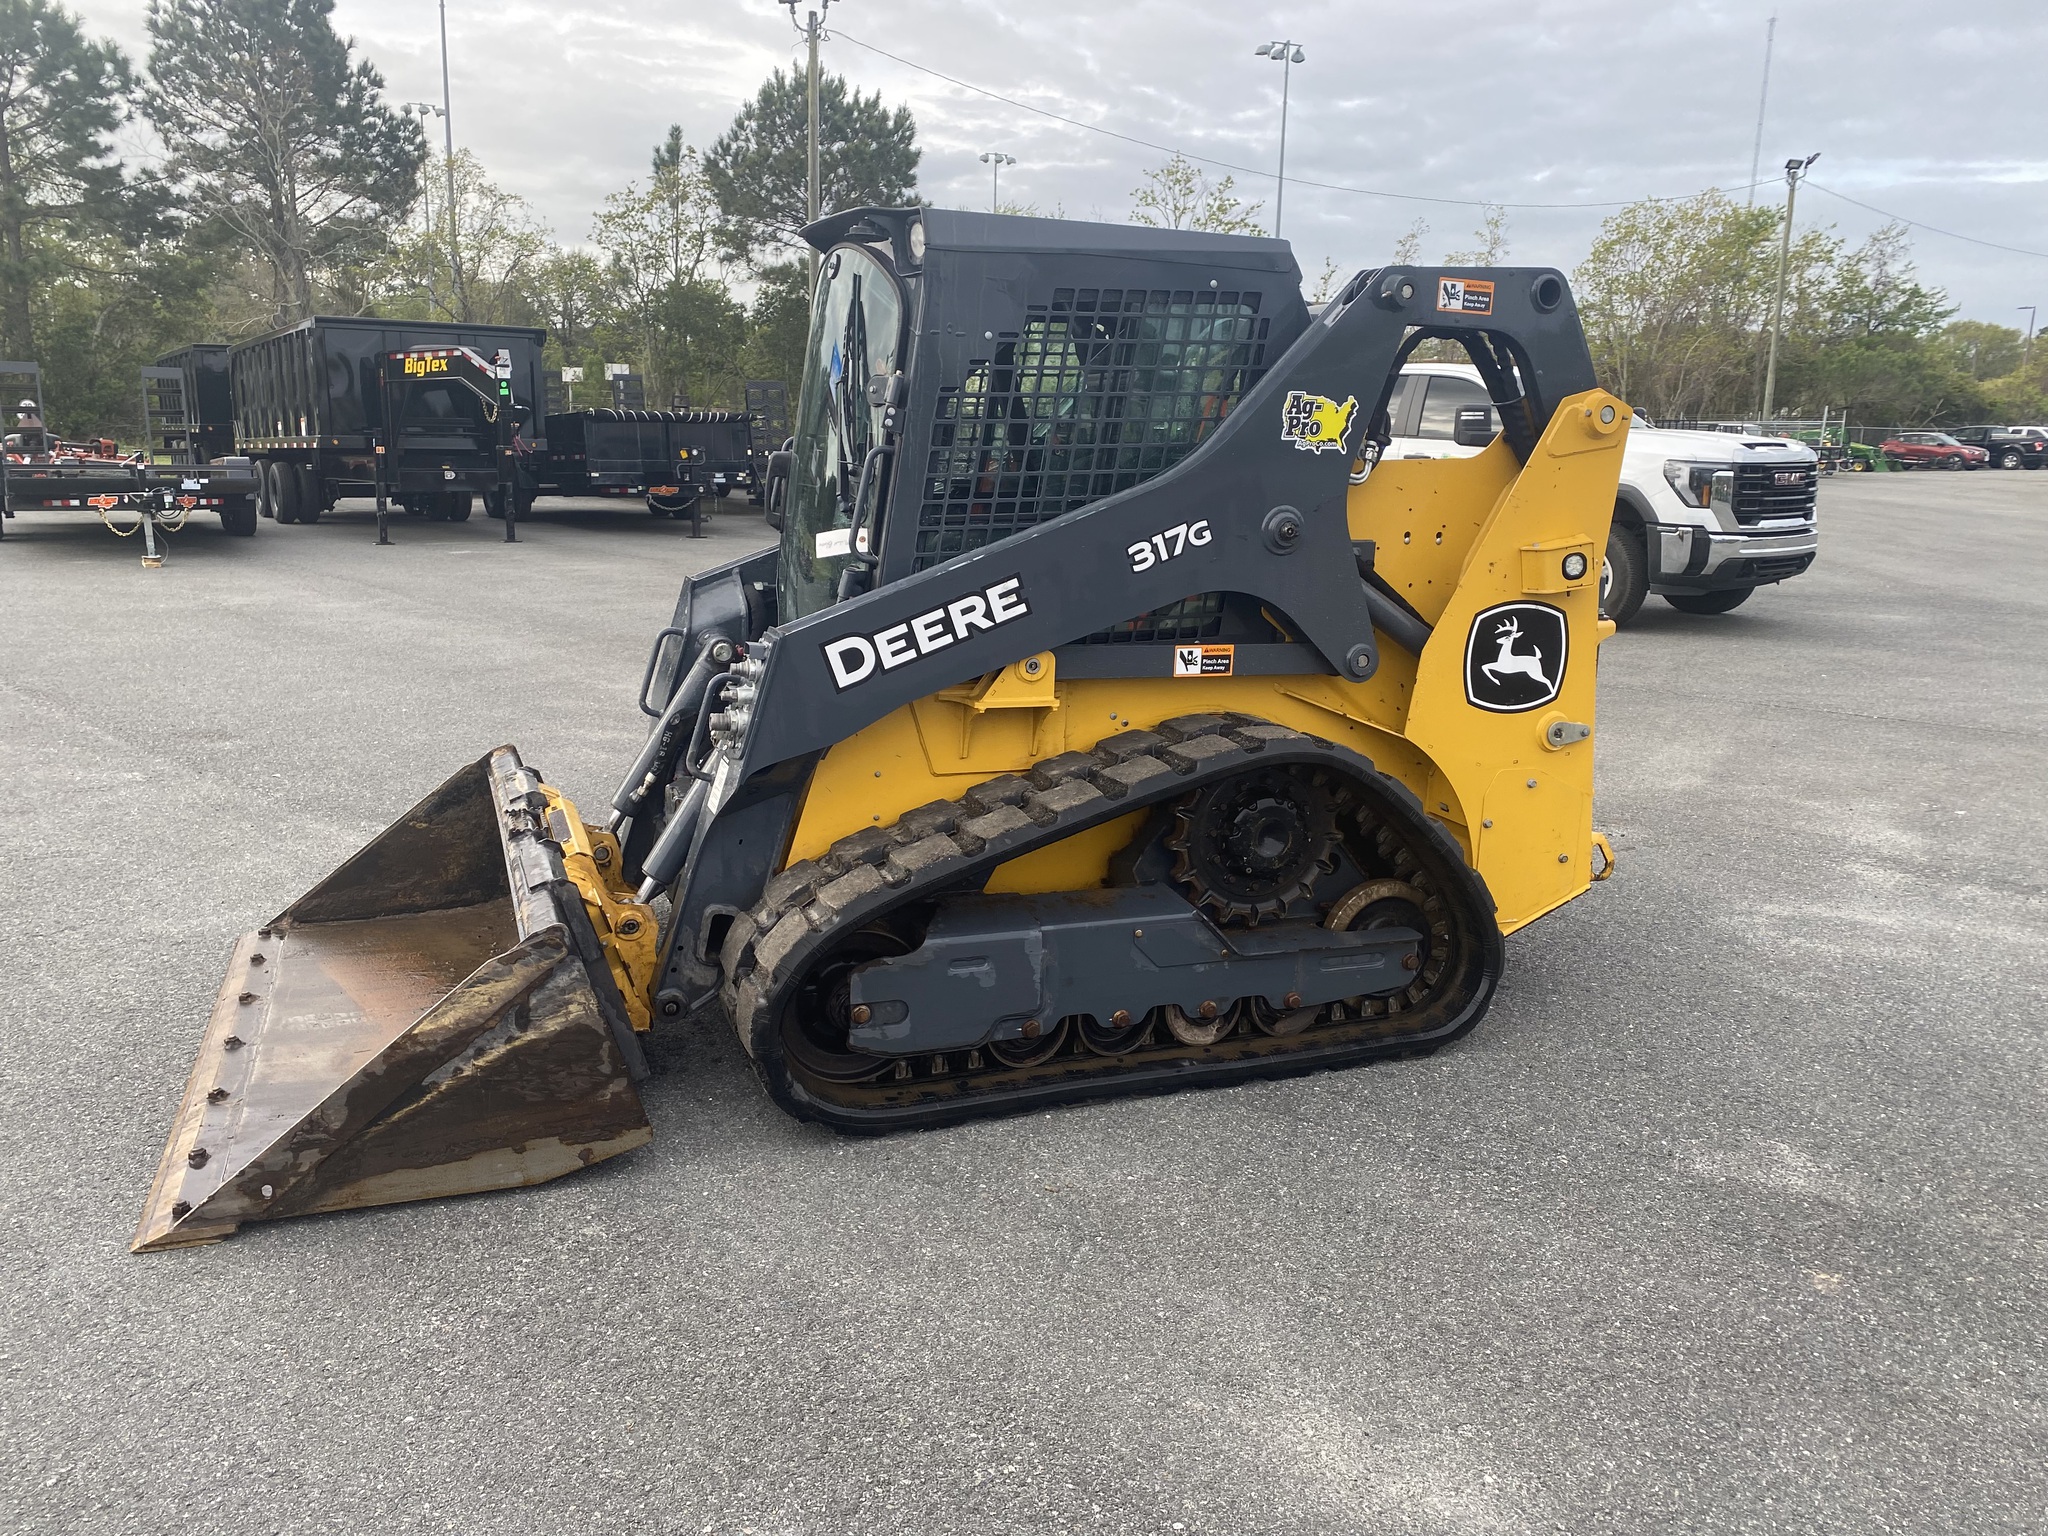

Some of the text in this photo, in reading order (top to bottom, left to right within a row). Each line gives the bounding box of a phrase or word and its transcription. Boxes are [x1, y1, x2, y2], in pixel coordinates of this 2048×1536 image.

[1479, 294, 1490, 302] Area
[404, 356, 448, 377] BigTex
[1287, 394, 1323, 420] Ag-
[1285, 415, 1321, 437] Pro
[1774, 472, 1807, 486] GMC
[1127, 519, 1213, 573] 317G
[824, 577, 1028, 690] DEERE
